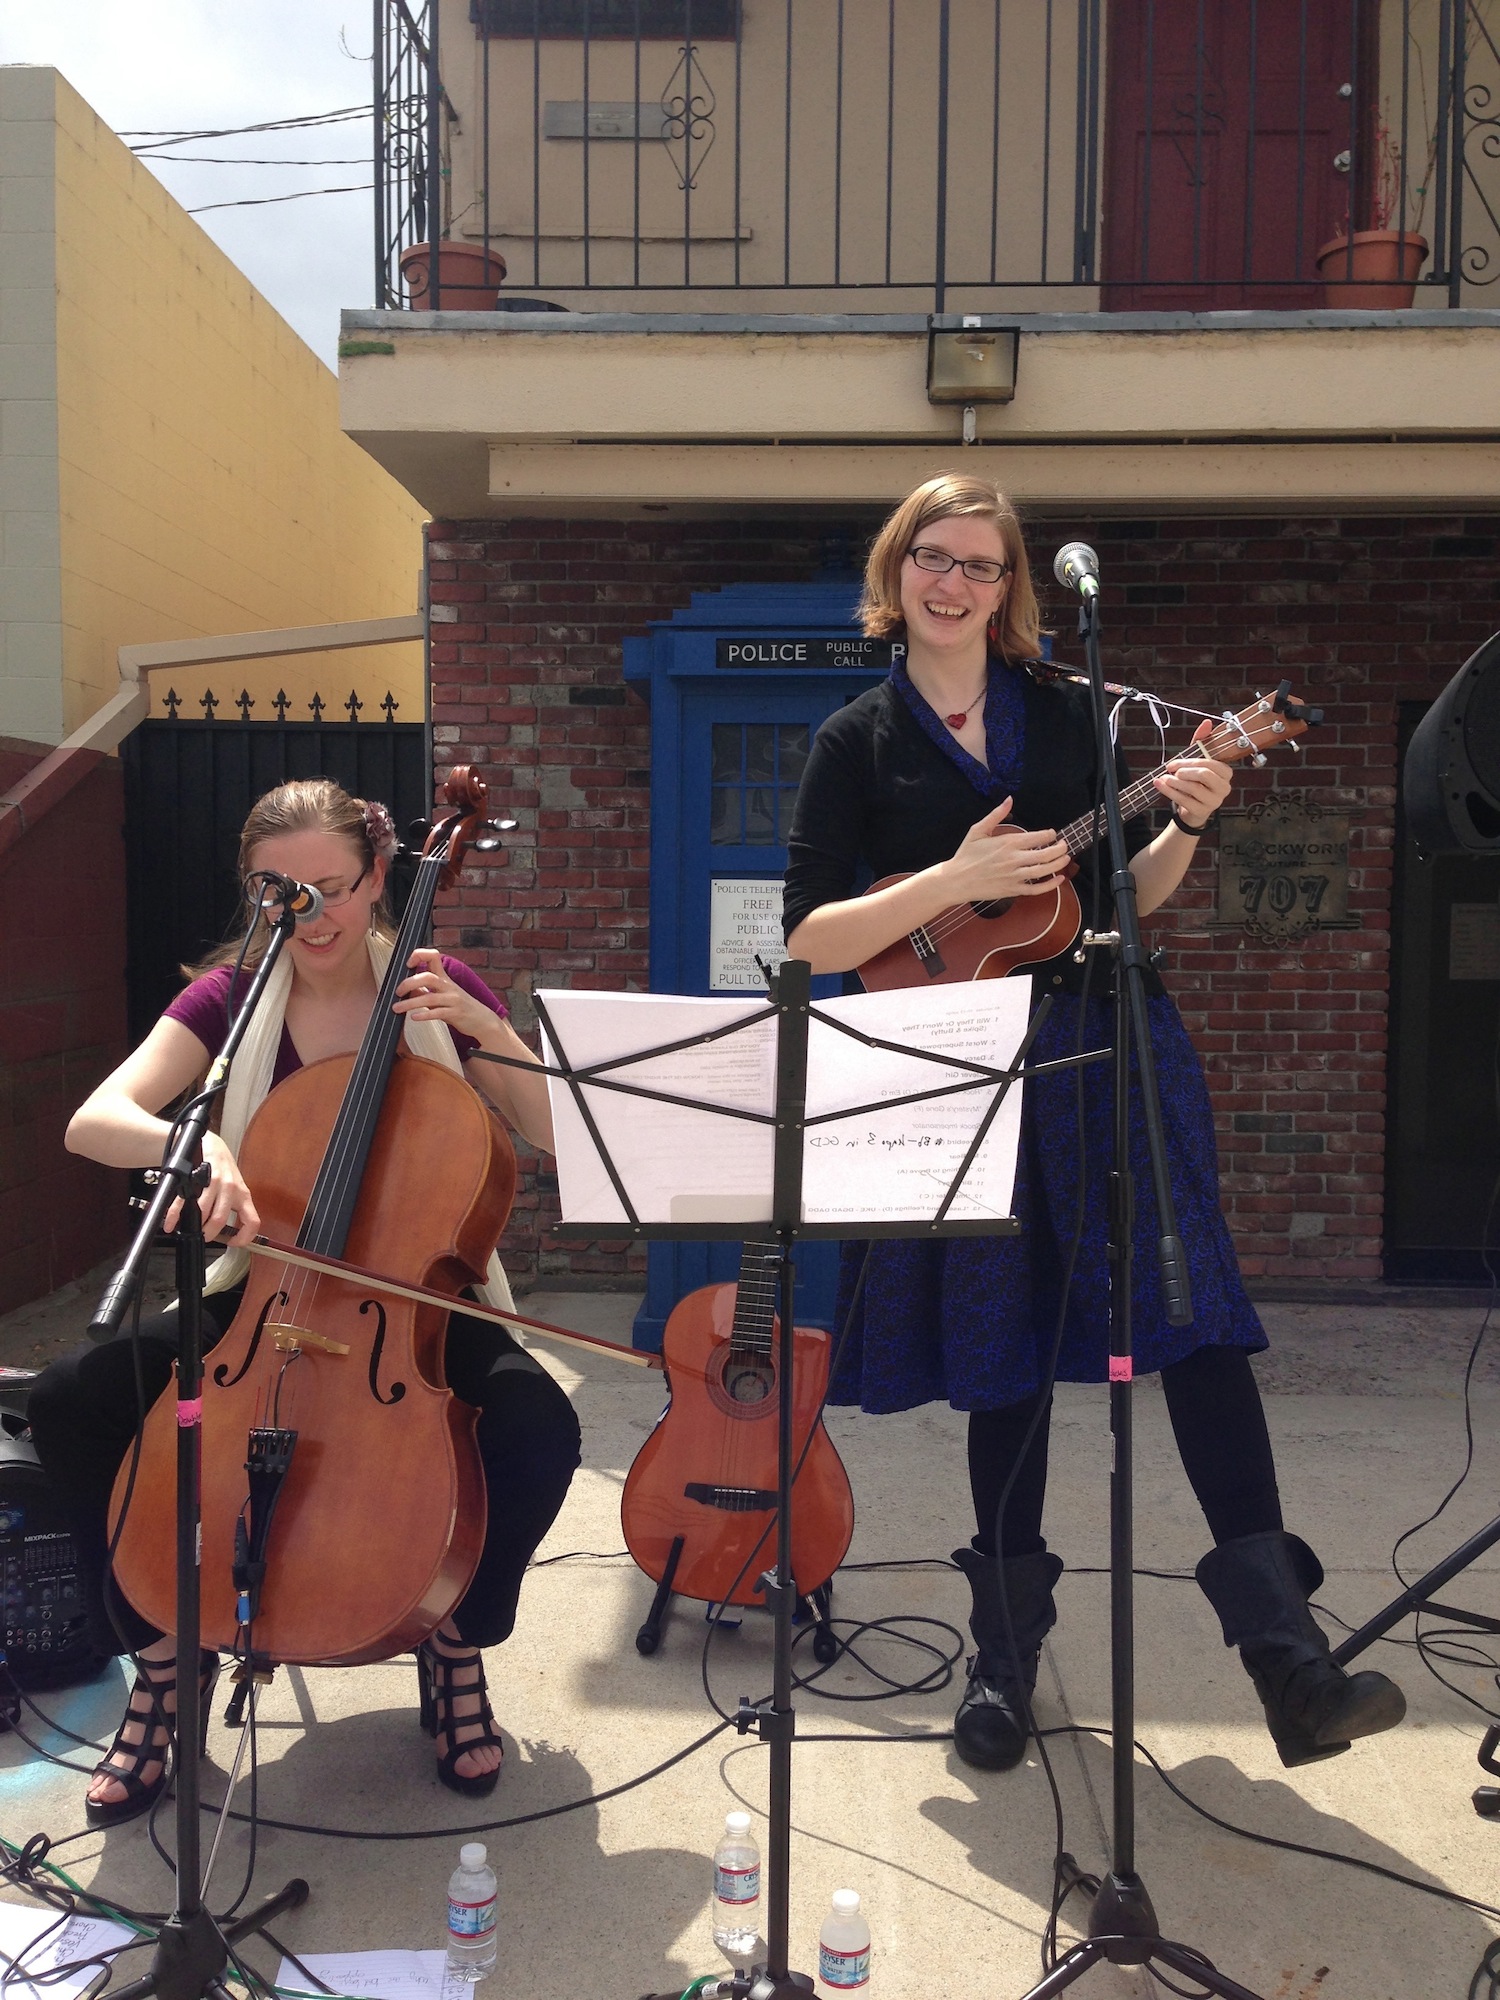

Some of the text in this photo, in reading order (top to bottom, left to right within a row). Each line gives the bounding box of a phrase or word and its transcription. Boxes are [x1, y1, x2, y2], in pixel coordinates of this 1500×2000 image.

[826, 642, 872, 653] PUBLIC
[728, 644, 807, 662] POLICE
[833, 656, 865, 667] CALL
[1238, 875, 1330, 913] 707
[743, 900, 773, 909] FREE
[737, 925, 778, 934] PUBLIC
[720, 974, 744, 984] PULL
[747, 974, 761, 984] TO
[24, 1533, 56, 1542] MIXPACK
